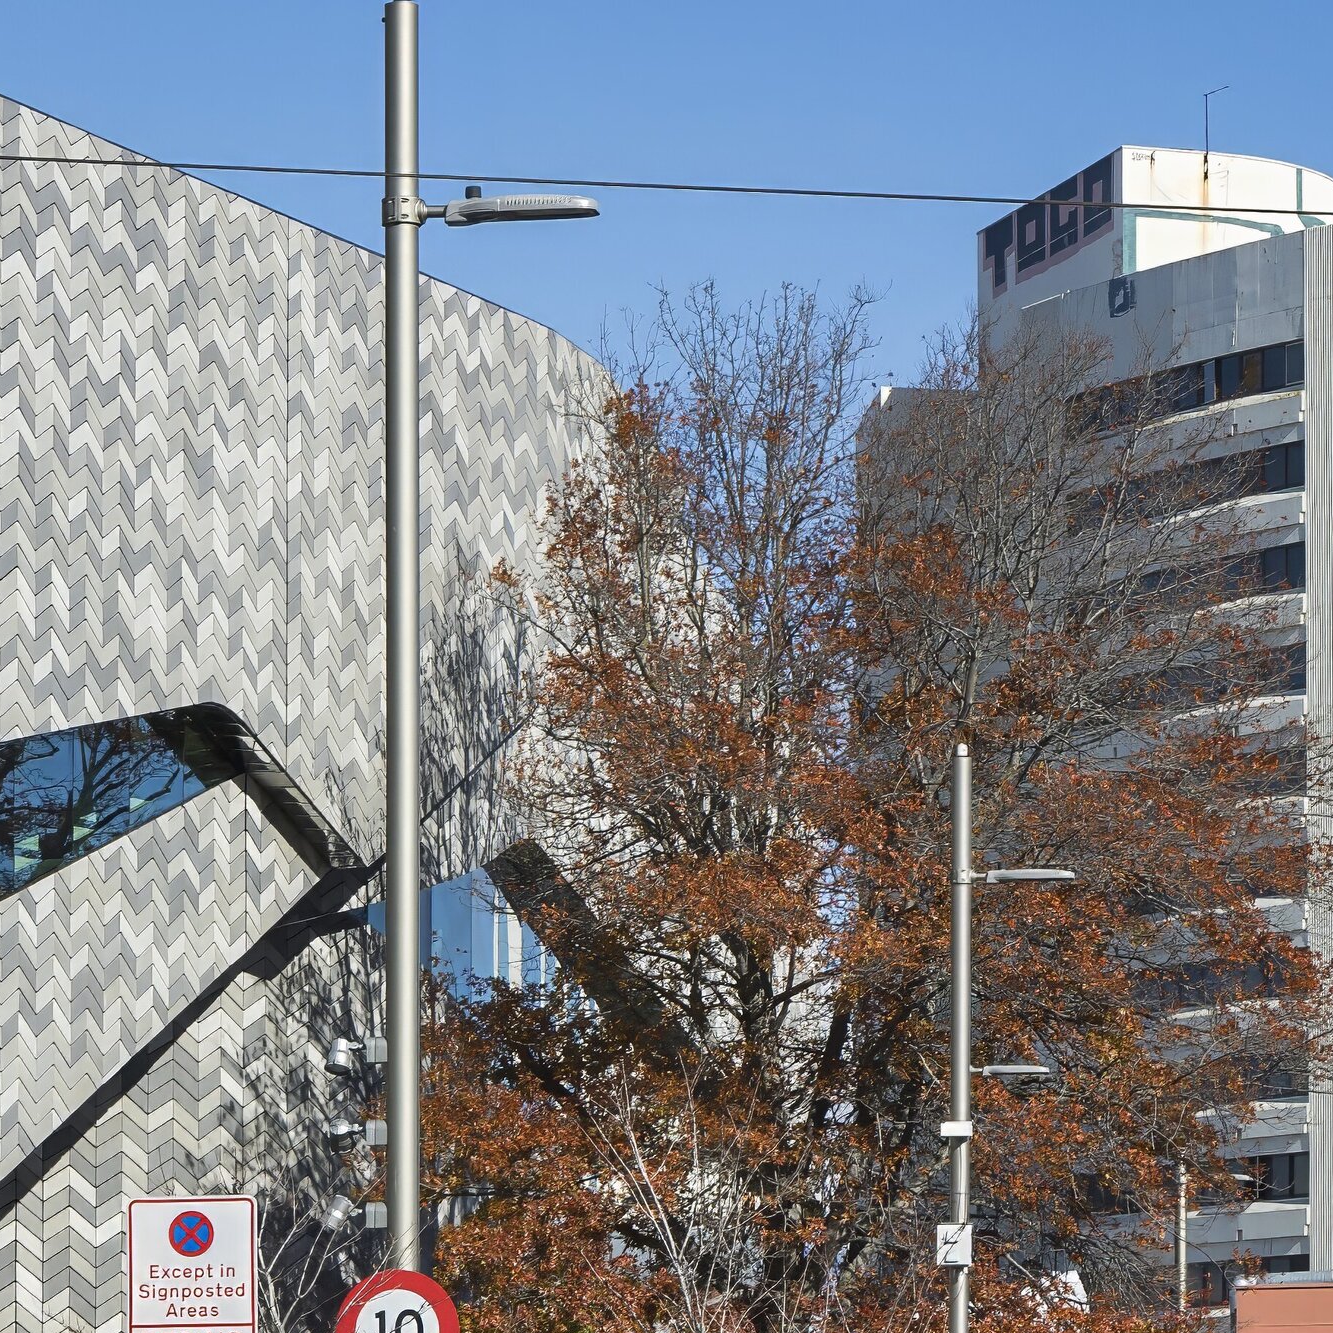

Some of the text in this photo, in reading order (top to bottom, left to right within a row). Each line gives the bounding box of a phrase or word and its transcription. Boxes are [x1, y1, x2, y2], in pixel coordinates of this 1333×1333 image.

[149, 1264, 236, 1282] Except in
[138, 1282, 245, 1301] Signposted
[165, 1303, 219, 1318] Areas
